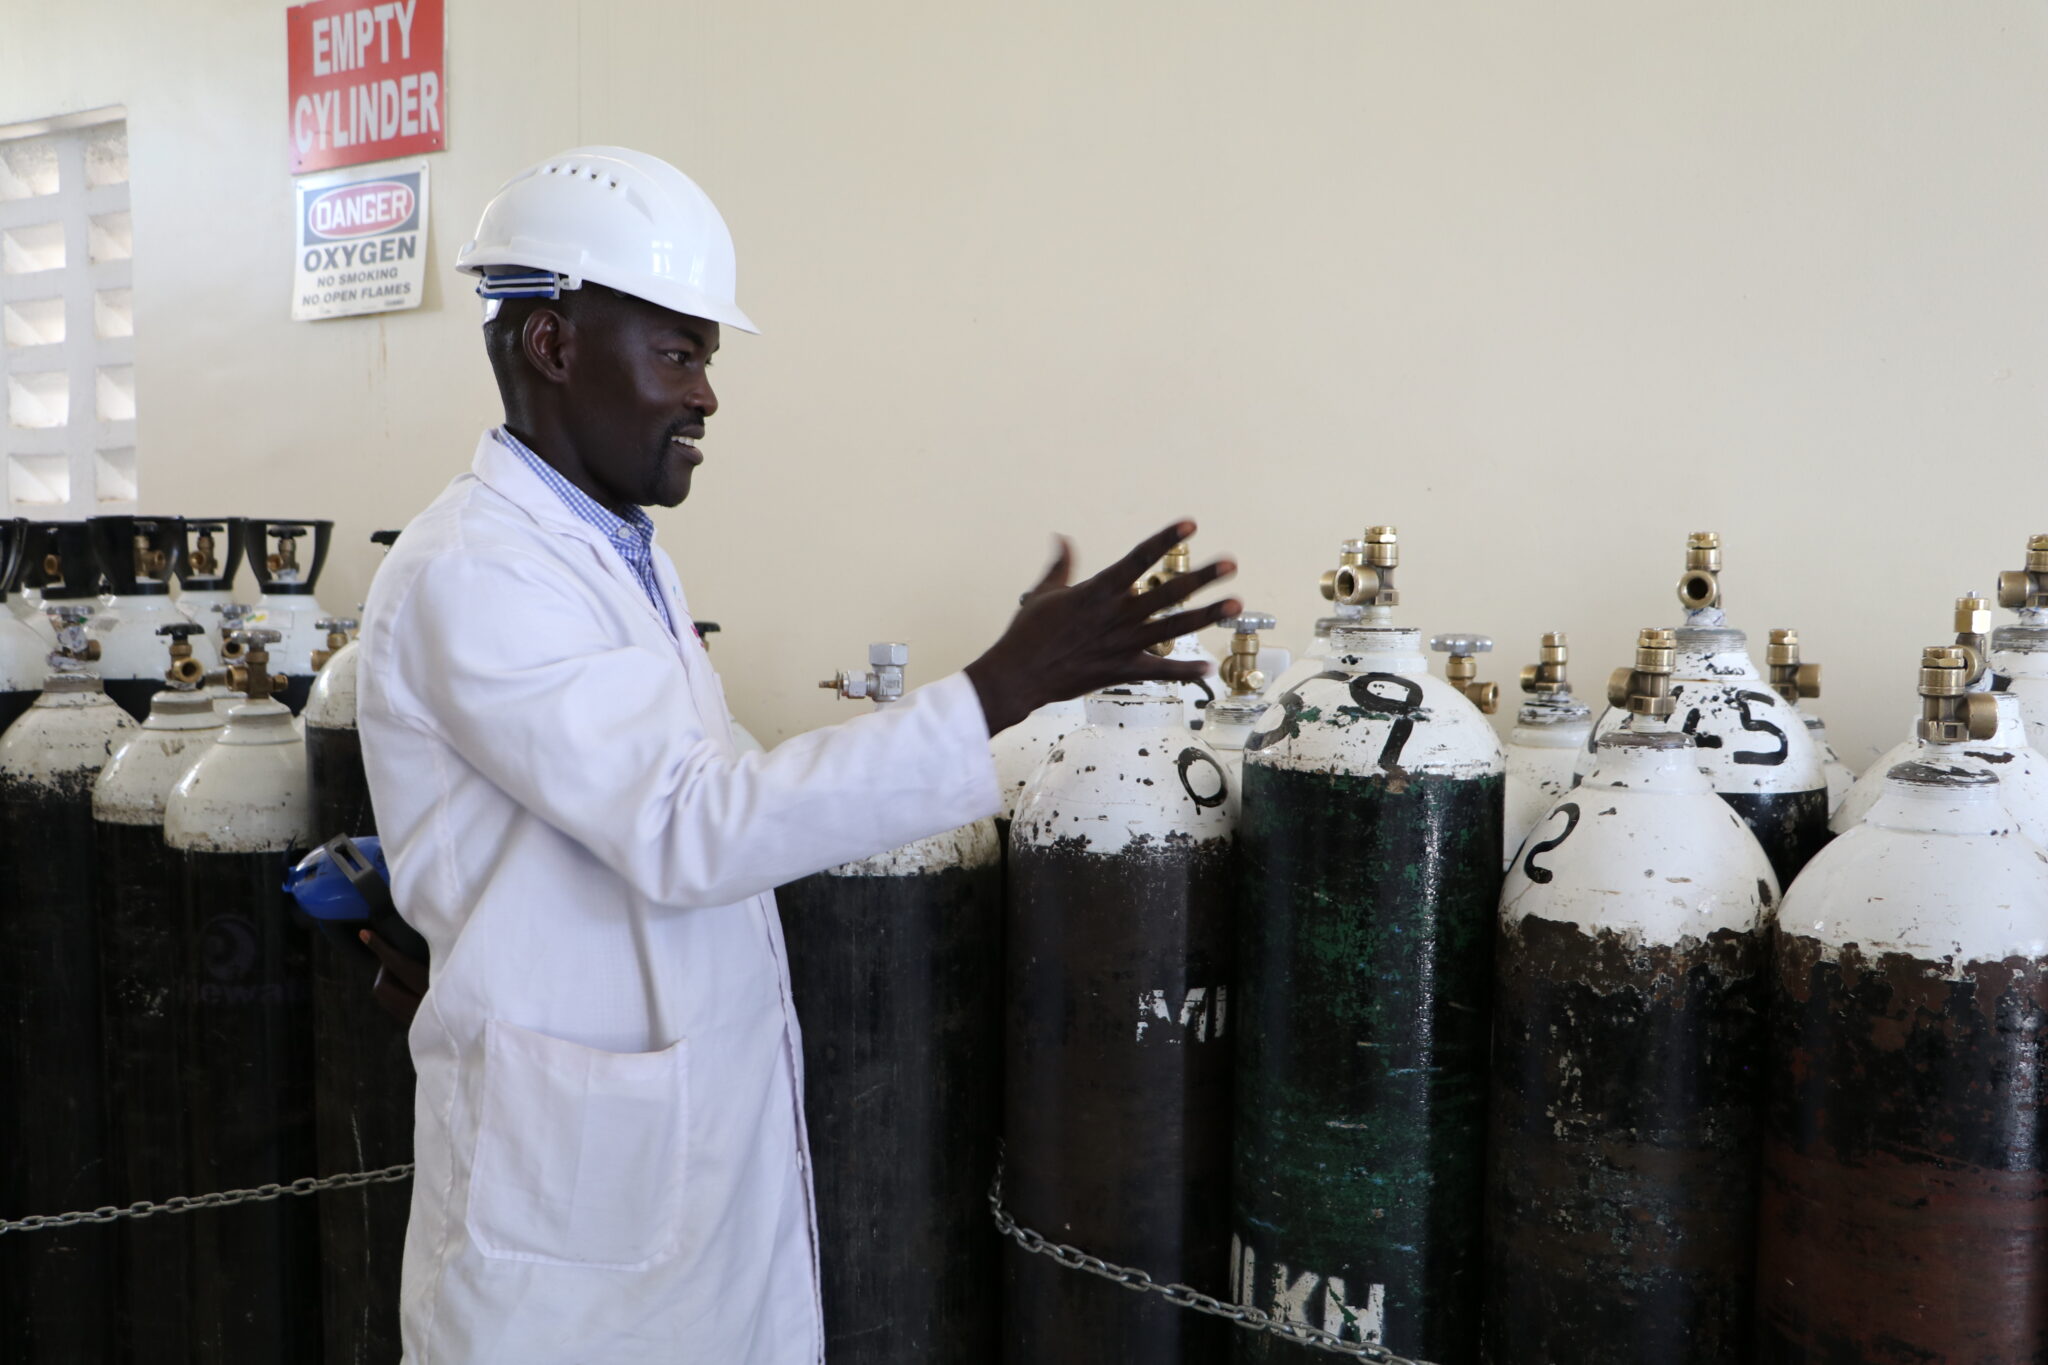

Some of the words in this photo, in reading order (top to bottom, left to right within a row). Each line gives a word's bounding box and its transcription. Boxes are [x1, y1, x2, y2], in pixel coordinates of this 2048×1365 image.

[313, 0, 416, 77] EMPTY
[294, 71, 440, 154] CYLINDER
[316, 189, 408, 231] DANGER
[304, 236, 417, 273] OXYGEN
[302, 295, 320, 306] NO
[323, 290, 357, 303] OPEN
[361, 282, 411, 299] FLAMES
[317, 276, 335, 288] NO
[339, 267, 399, 285] SMOKING
